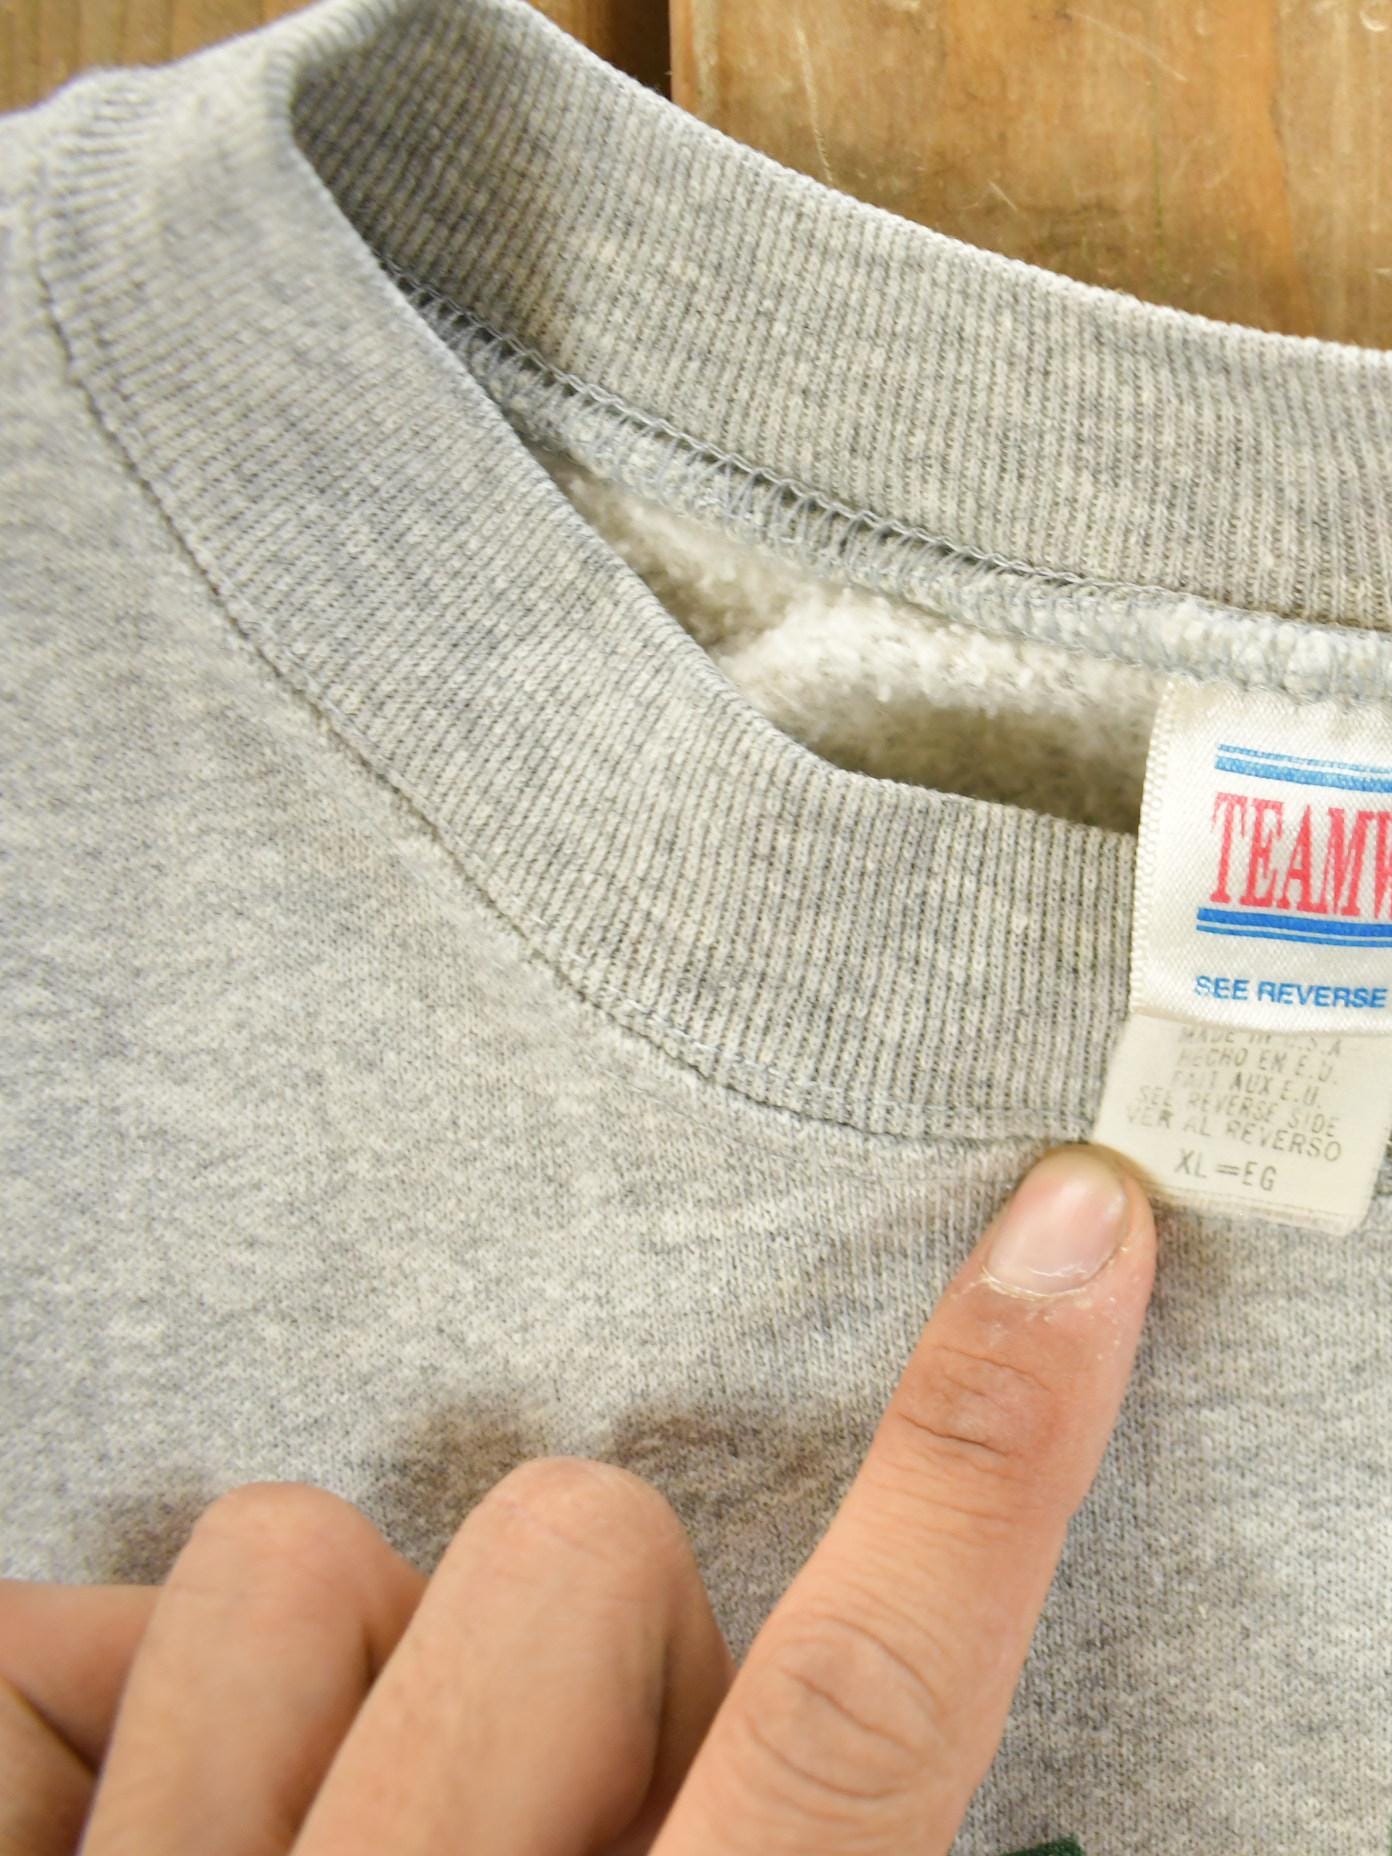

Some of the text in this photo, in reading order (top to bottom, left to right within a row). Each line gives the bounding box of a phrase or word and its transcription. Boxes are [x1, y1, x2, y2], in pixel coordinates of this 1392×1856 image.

[1194, 976, 1250, 1001] SEE
[1258, 980, 1387, 1009] REVERSE
[1229, 1071, 1273, 1096] AUX
[1139, 1085, 1341, 1138] SEE REVERSE SIDE
[1182, 1116, 1212, 1138] AL
[1226, 1119, 1343, 1162] REVERSO
